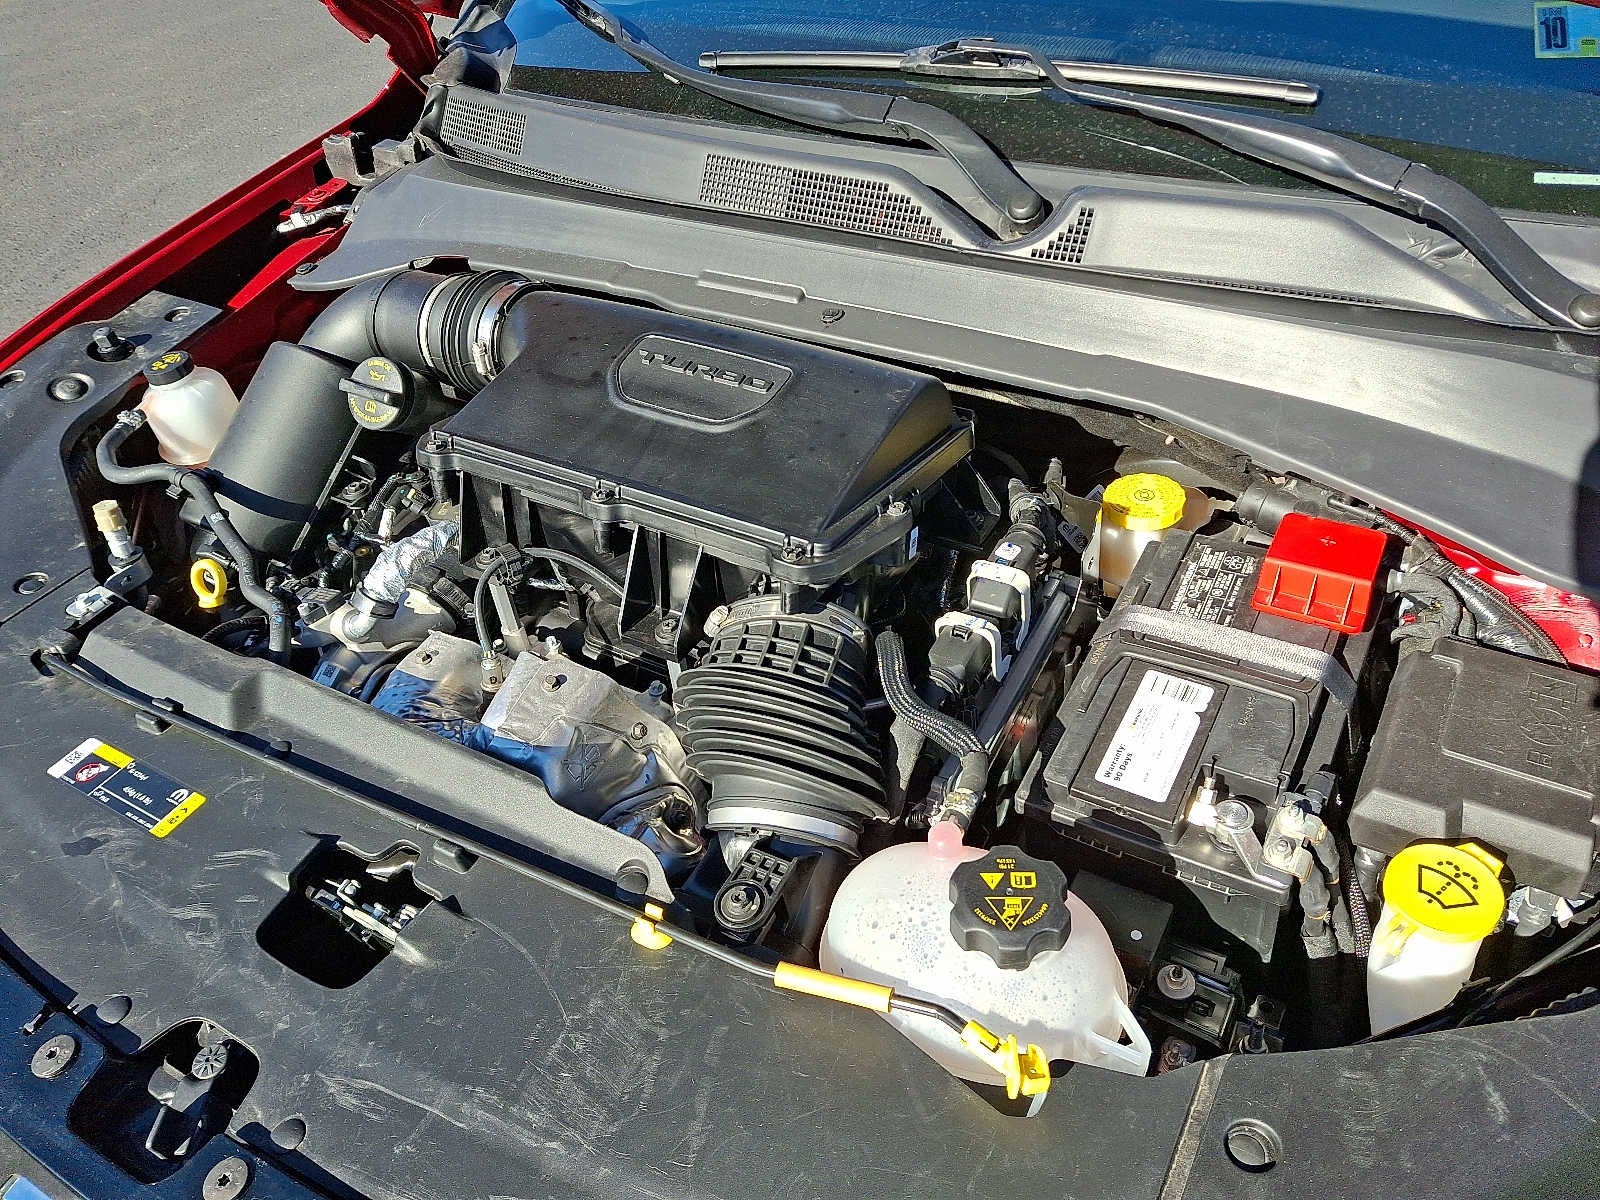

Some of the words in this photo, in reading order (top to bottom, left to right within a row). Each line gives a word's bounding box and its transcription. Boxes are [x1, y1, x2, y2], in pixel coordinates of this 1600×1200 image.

[1540, 16, 1568, 49] 10
[639, 349, 774, 394] TURBO
[1104, 743, 1126, 778] Warranty:
[1114, 771, 1123, 781] 90
[1119, 753, 1133, 771] Days
